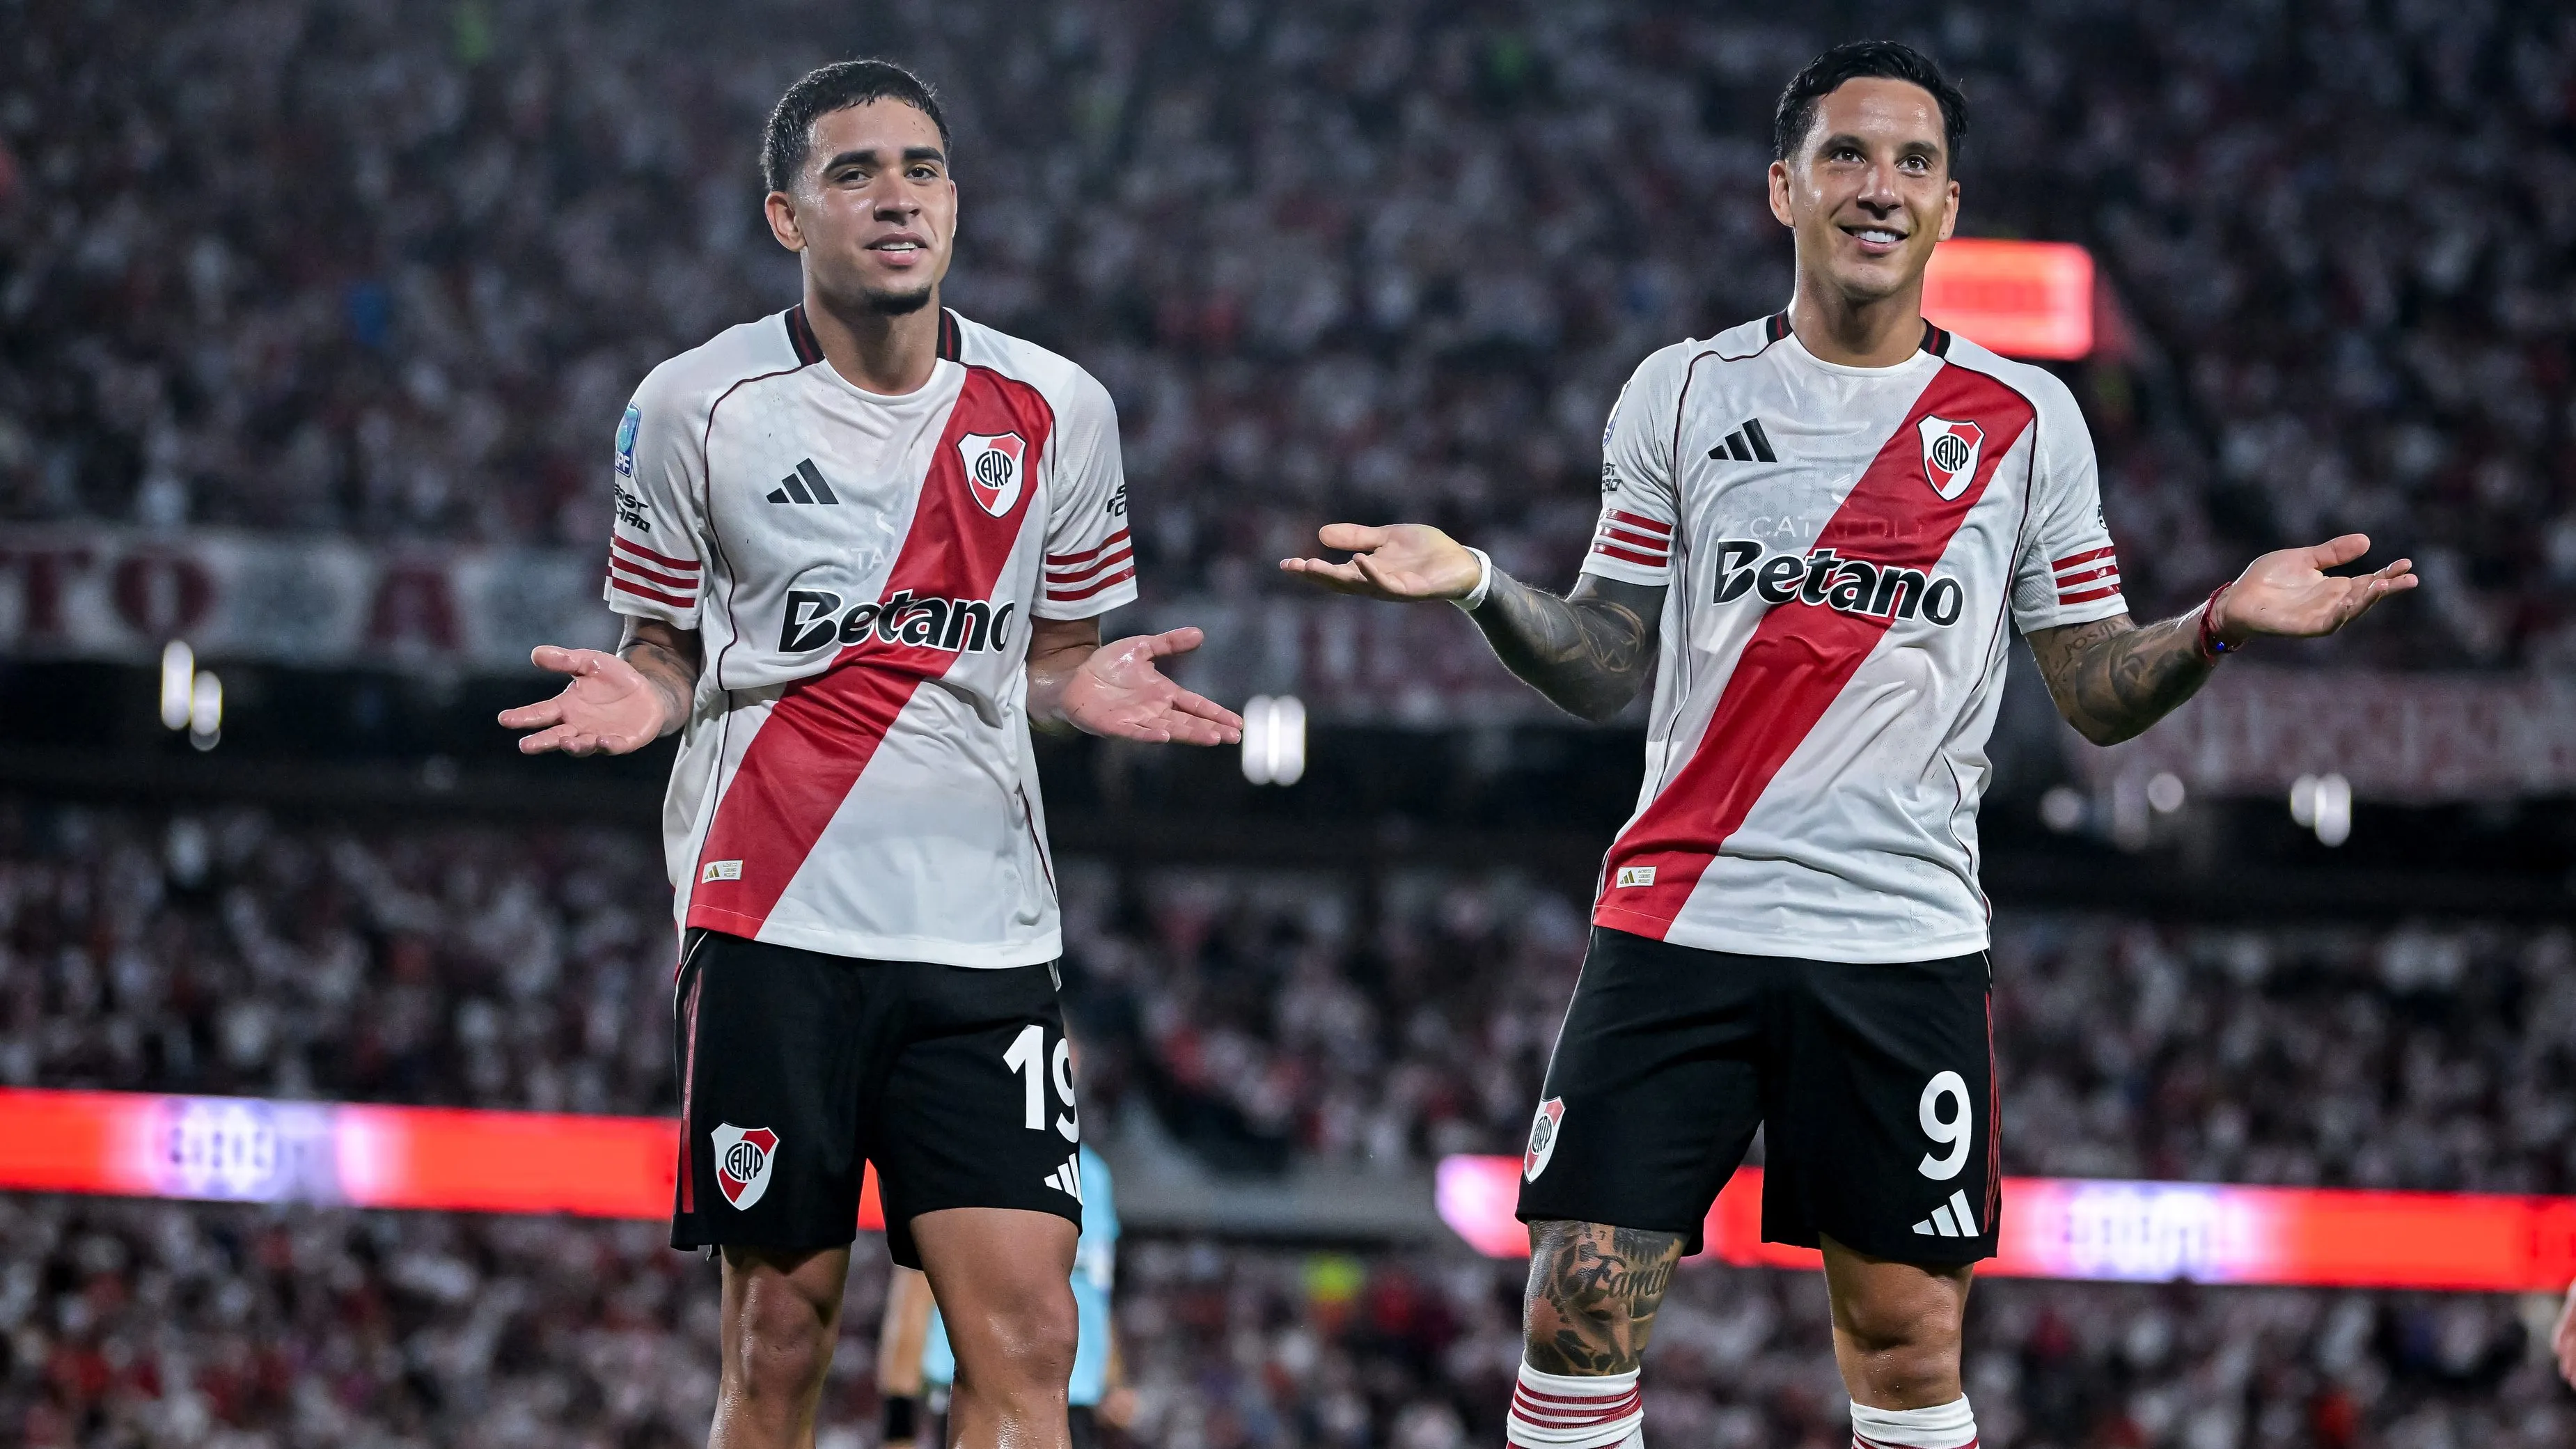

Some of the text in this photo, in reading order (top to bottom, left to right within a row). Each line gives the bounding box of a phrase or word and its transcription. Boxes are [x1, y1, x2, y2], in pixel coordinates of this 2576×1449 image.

[975, 450, 1013, 487] CARP
[1932, 434, 1970, 471] CARP
[617, 502, 651, 534] ARD
[1712, 539, 1964, 628] Betano
[1003, 1024, 1079, 1143] 19
[1918, 1070, 1972, 1180] 9
[725, 1143, 764, 1181] CARP
